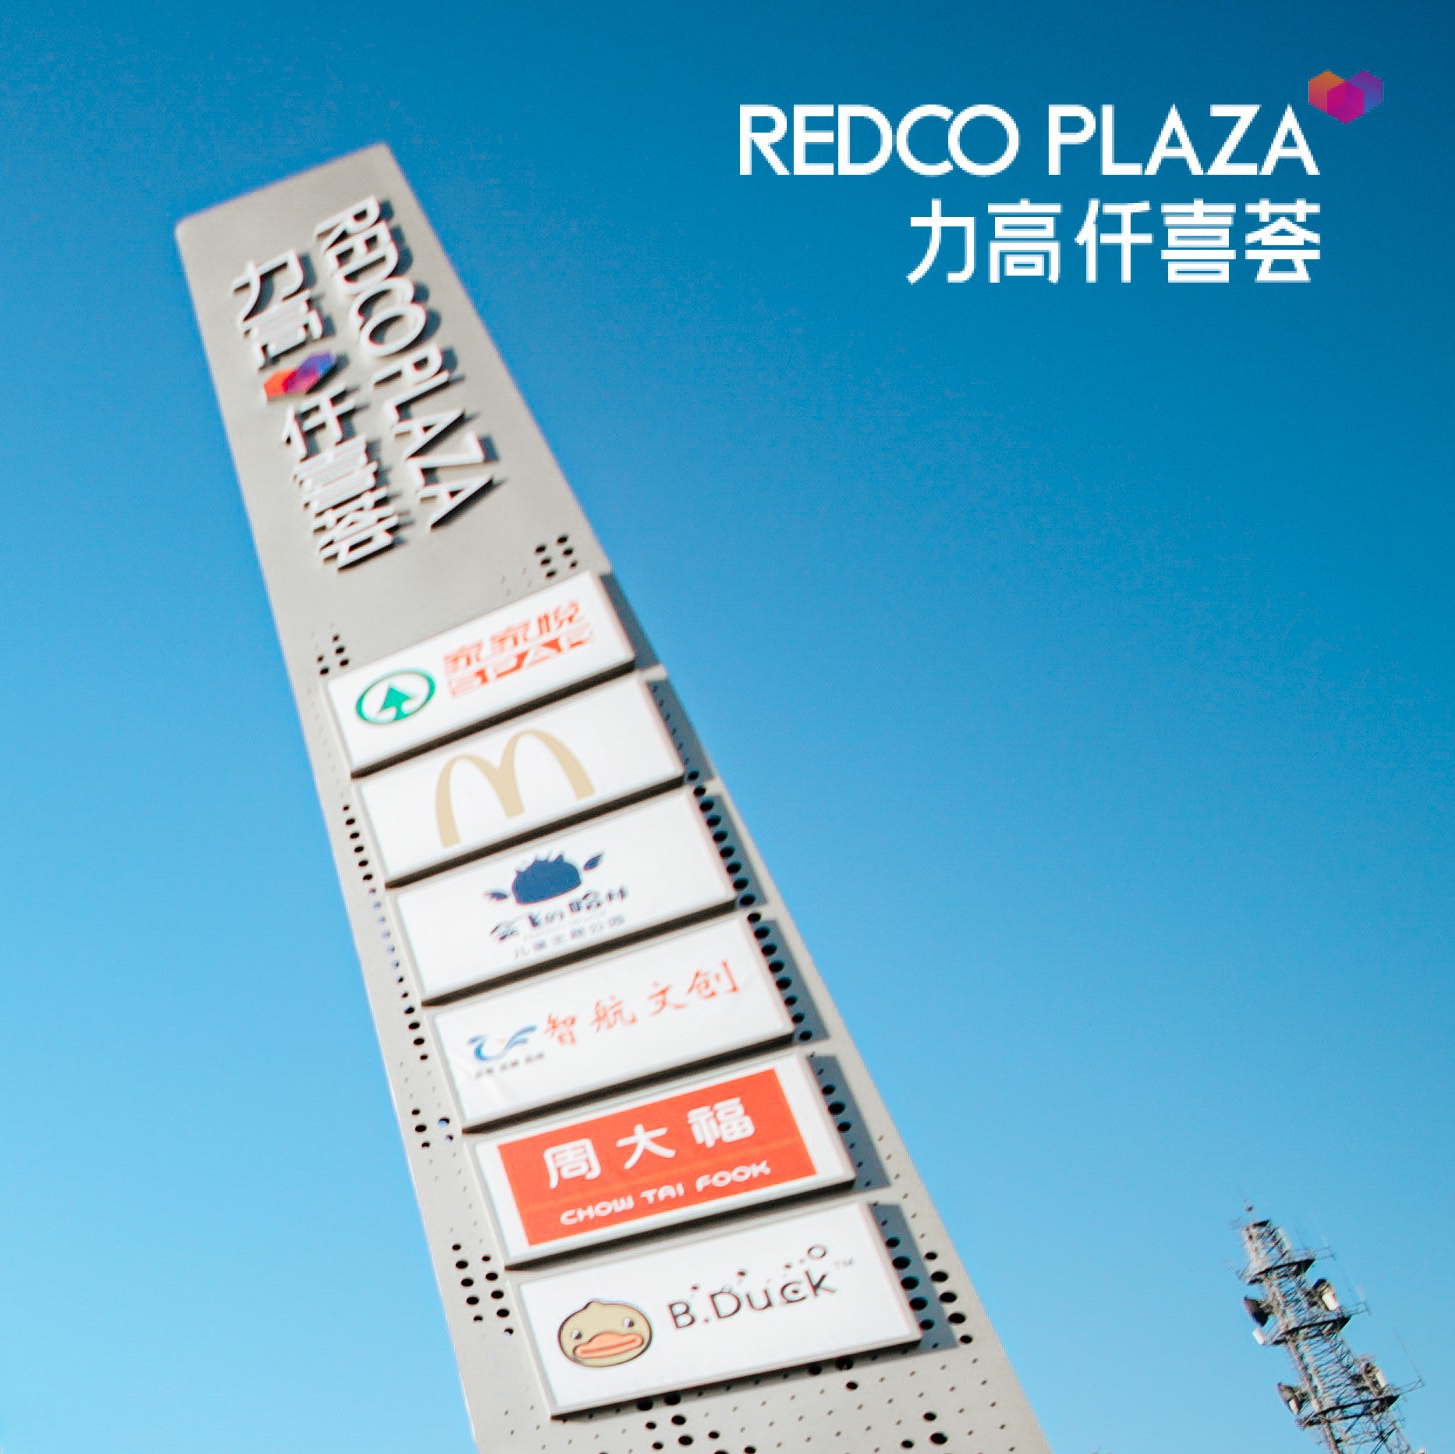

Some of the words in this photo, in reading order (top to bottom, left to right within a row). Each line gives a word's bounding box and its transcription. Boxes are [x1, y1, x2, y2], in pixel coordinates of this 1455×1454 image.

[314, 195, 427, 357] REDCO
[374, 343, 496, 531] PLAZA
[544, 960, 740, 1045] 智航文创
[543, 1097, 756, 1189] 周大福
[560, 1194, 635, 1226] CHOW
[640, 1182, 685, 1205] TAI
[695, 1160, 772, 1192] FOOK
